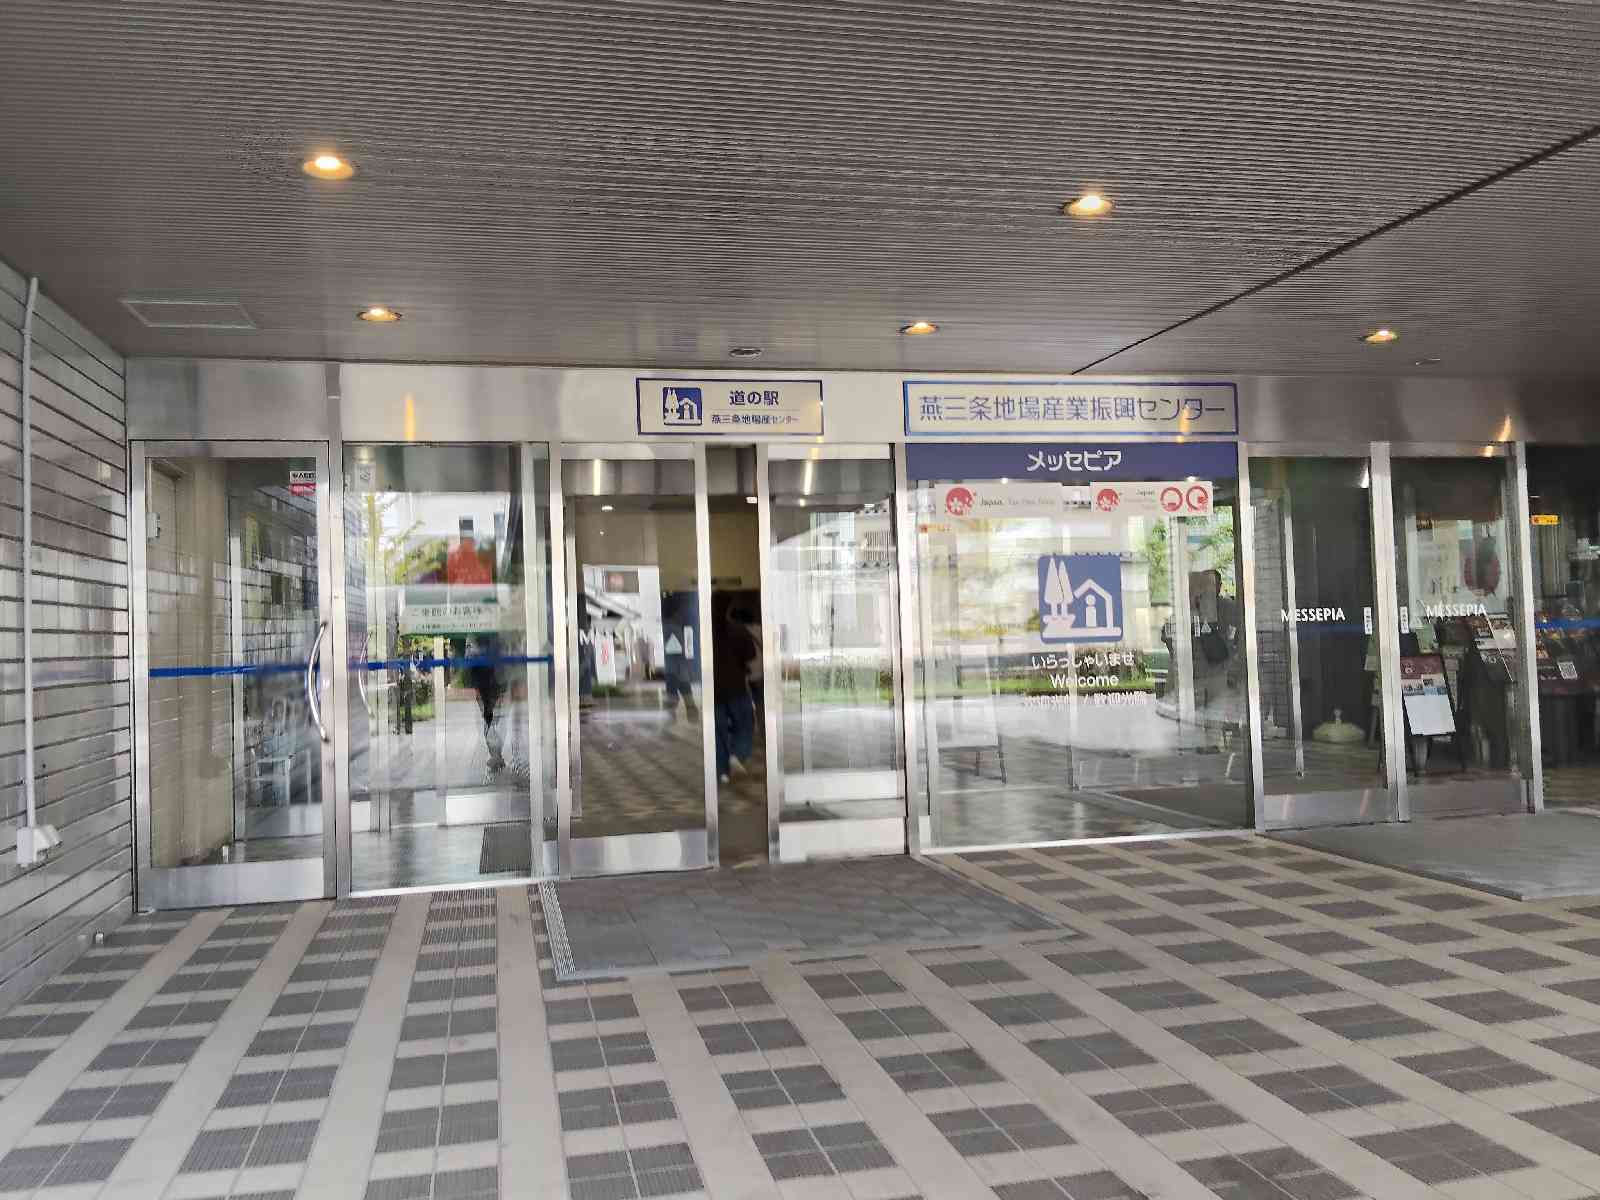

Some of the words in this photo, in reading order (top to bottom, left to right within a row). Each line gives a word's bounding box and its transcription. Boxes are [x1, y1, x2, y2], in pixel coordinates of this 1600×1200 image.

[729, 390, 779, 406] 道の駅
[919, 395, 1226, 422] 燕三条地場産業振興センター
[1026, 450, 1122, 471] メッセピア
[1281, 607, 1346, 622] MESSEPIA
[1426, 603, 1486, 617] MESSEPIA
[1031, 651, 1135, 669] いらっしゃいませ
[1049, 673, 1119, 689] Welcome
